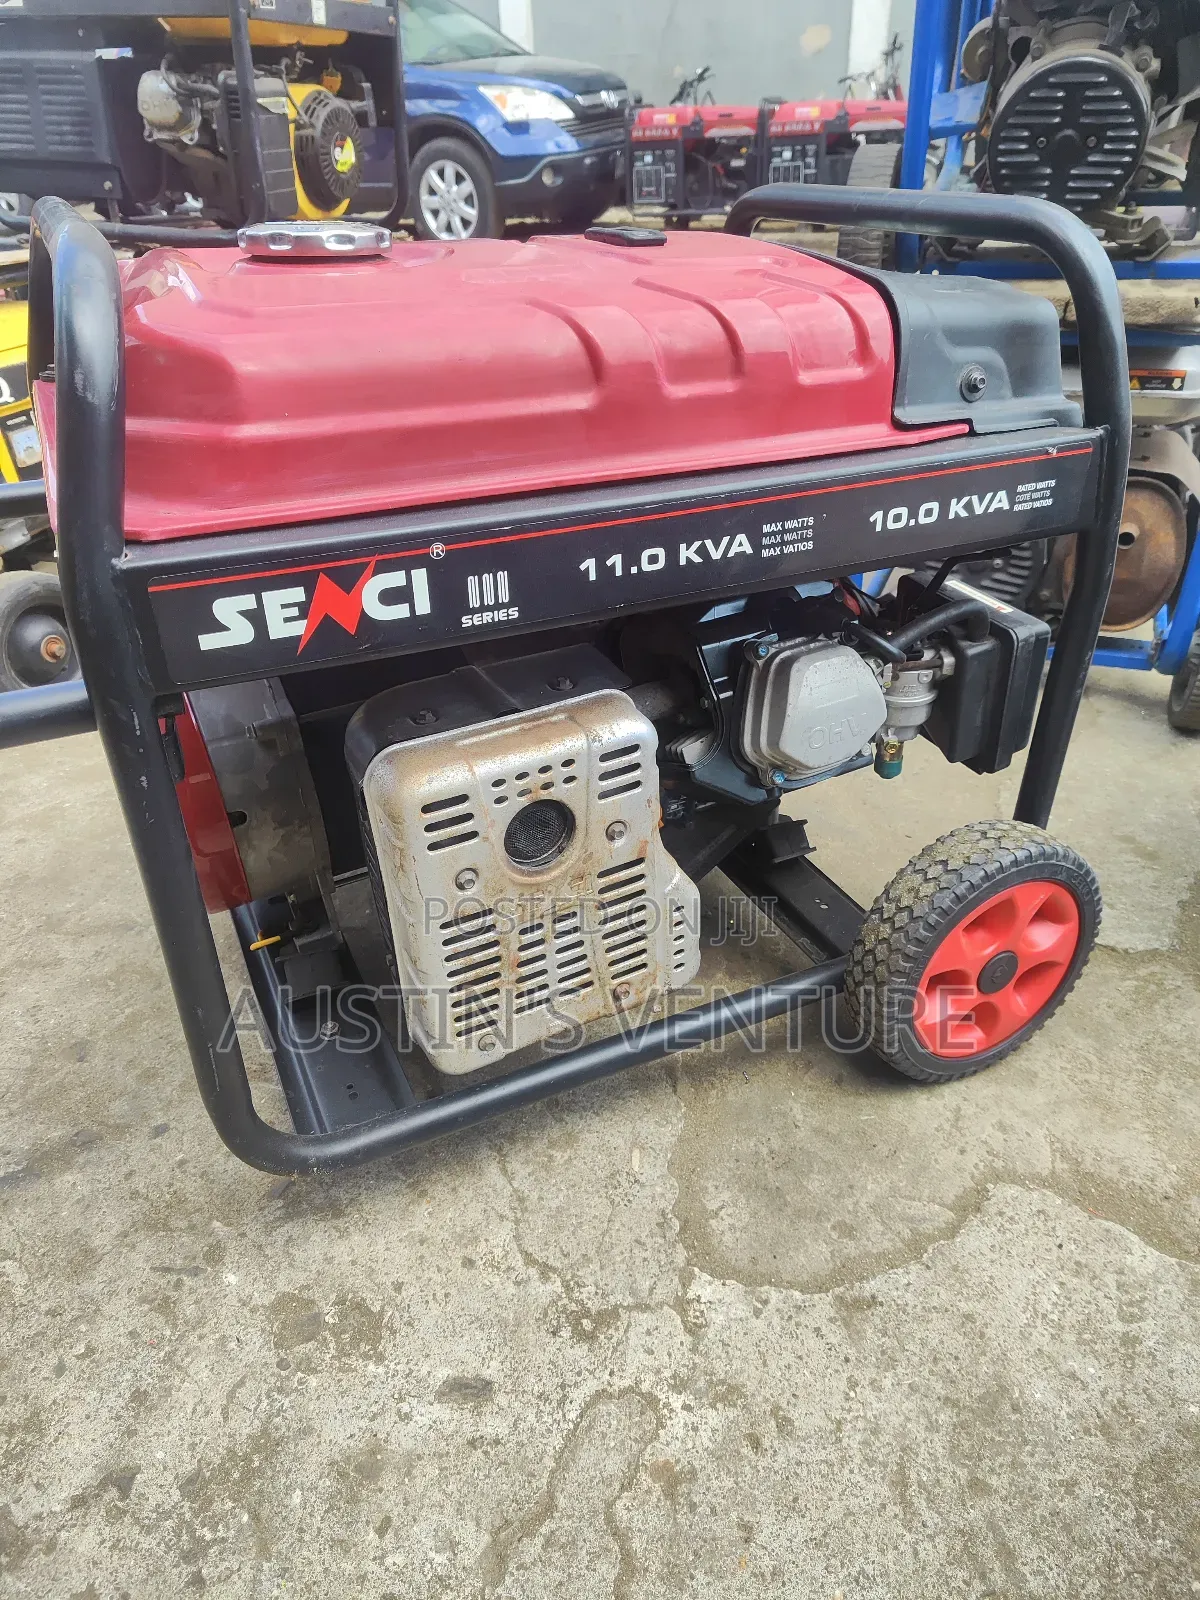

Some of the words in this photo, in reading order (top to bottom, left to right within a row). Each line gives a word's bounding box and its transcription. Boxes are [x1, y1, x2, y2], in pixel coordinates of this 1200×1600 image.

[1017, 482, 1037, 493] RATED
[1036, 479, 1057, 490] WATTS
[1031, 489, 1051, 499] WATTS
[869, 501, 940, 532] 10.0
[948, 490, 1010, 520] KVA
[1013, 501, 1033, 512] RATED
[762, 521, 783, 533] MAX
[784, 516, 814, 530] WATTS
[762, 534, 782, 546] MAX
[783, 528, 814, 542] WATTS
[578, 547, 666, 582] 11.0
[678, 533, 754, 566] KVA
[761, 546, 782, 558] MAX
[782, 540, 814, 554] VATIOS
[197, 553, 432, 656] SENCI
[461, 606, 519, 628] SERIES
